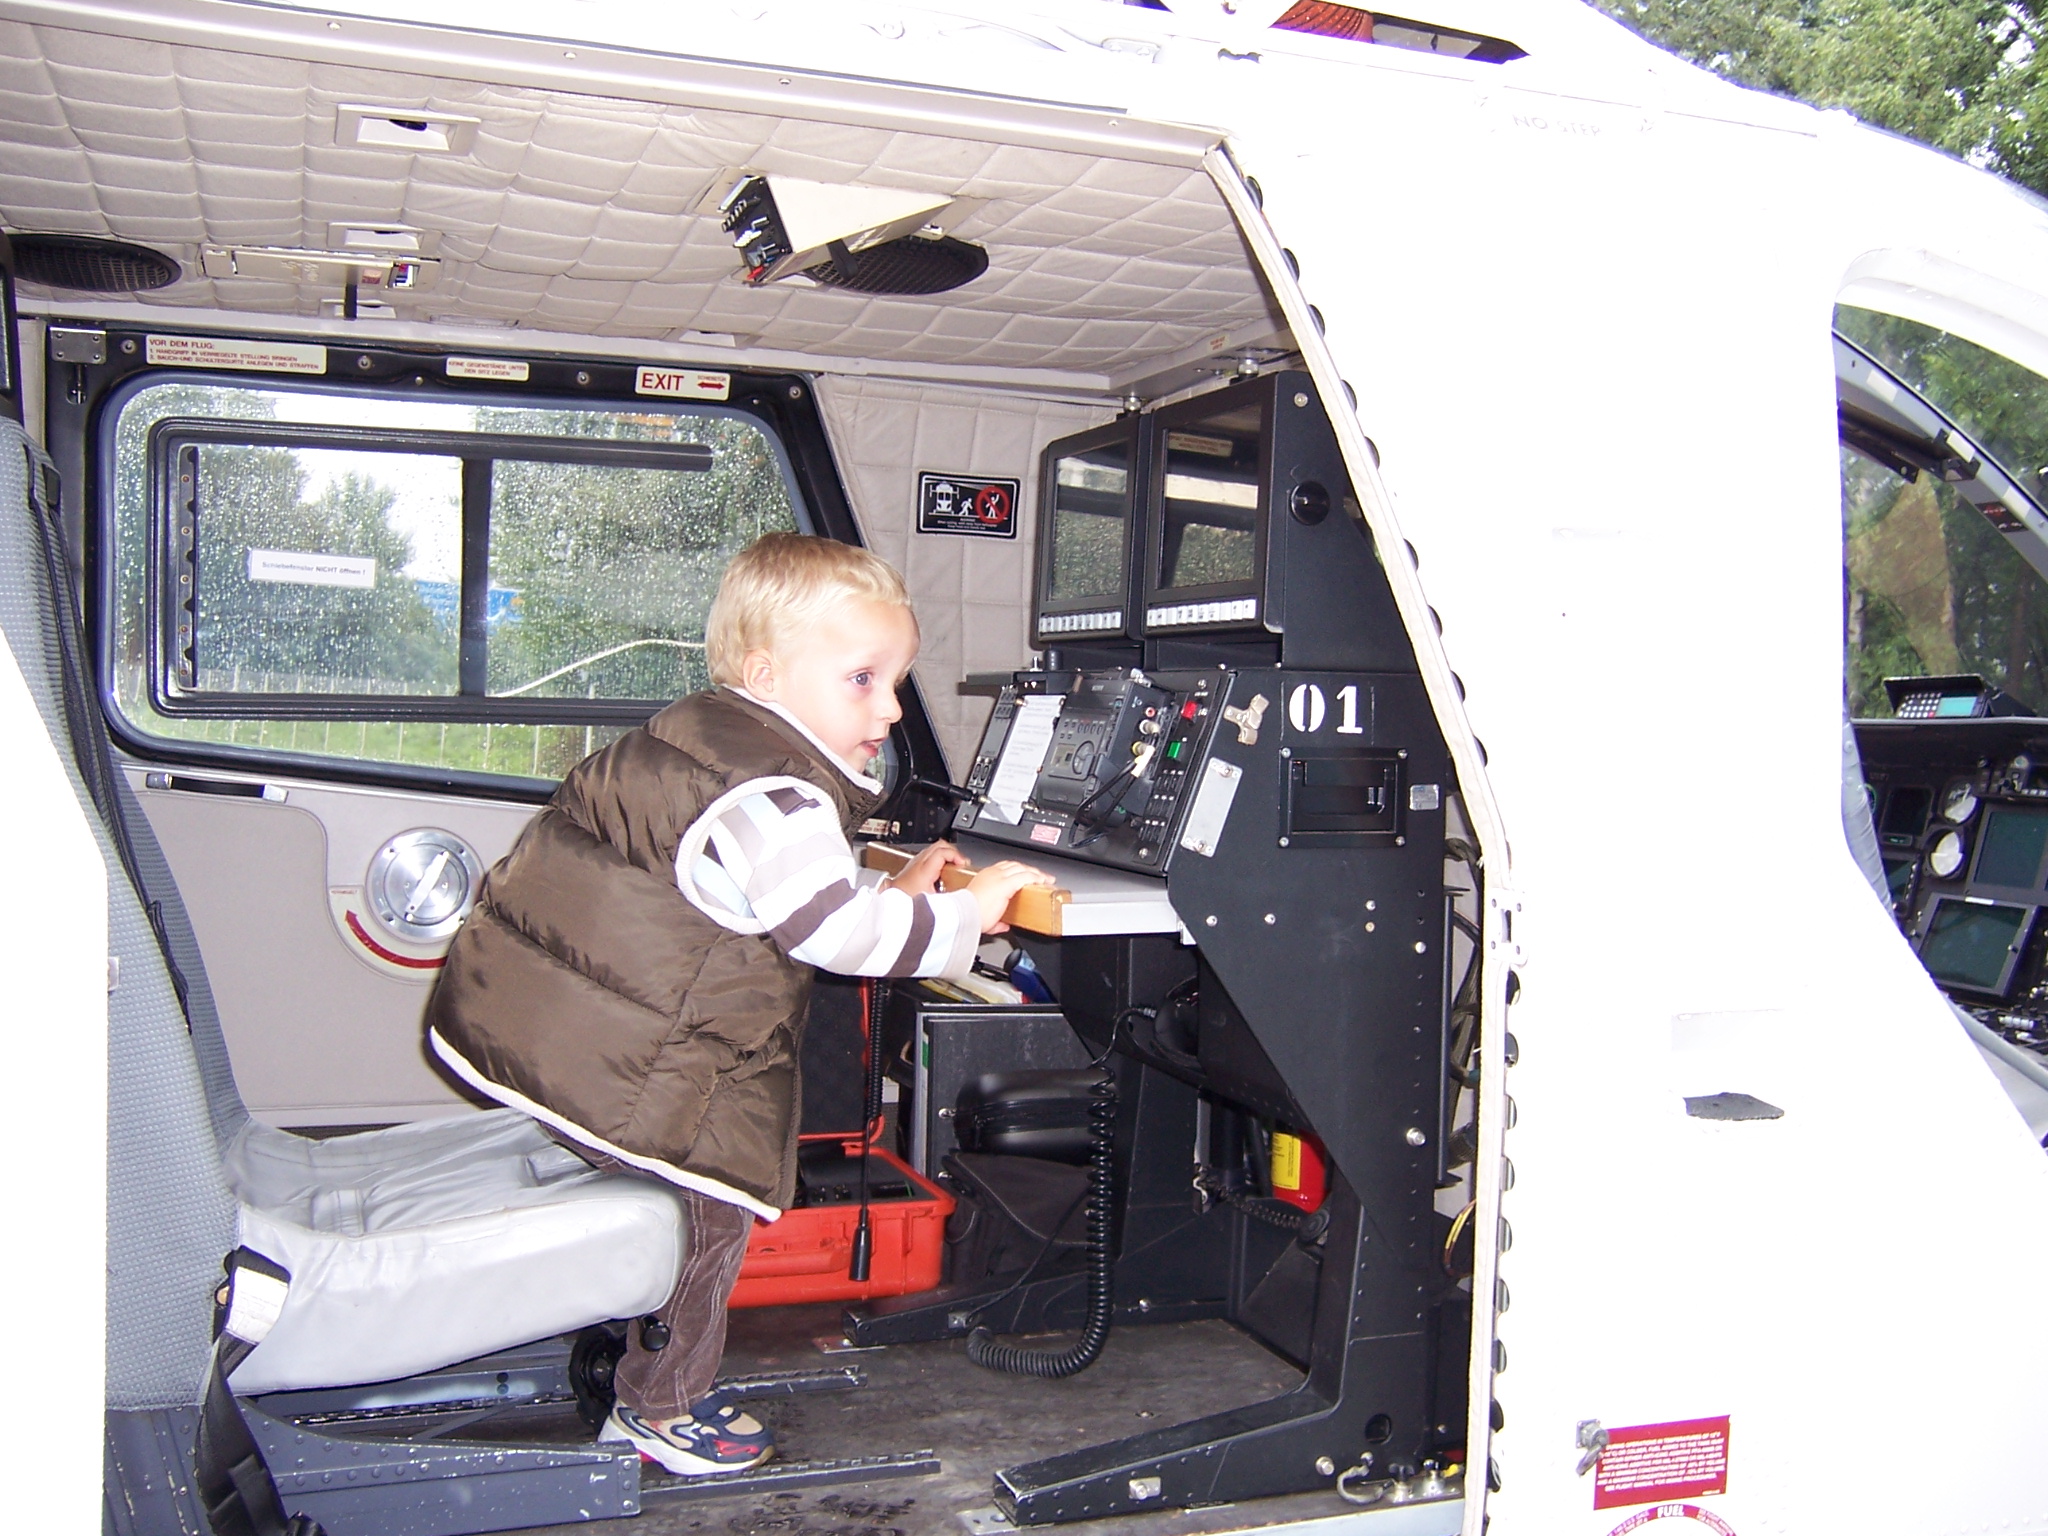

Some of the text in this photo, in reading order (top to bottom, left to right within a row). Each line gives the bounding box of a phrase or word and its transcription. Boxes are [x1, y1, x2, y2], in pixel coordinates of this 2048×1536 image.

[1512, 114, 1601, 136] NO STEP
[149, 339, 215, 349] VOR DEM FLUG:
[641, 372, 684, 391] EXIT
[262, 561, 314, 572] Schiebefenster
[315, 566, 337, 574] NICHT
[339, 567, 361, 575] öffnen
[1289, 683, 1363, 734] 01
[1605, 1442, 1624, 1450] DURING
[1625, 1438, 1656, 1448] OPERATIONS
[1663, 1433, 1701, 1443] TEMPERATURES
[1661, 1442, 1678, 1451] ADDED
[1624, 1454, 1642, 1462] EITHER
[1668, 1448, 1690, 1456] ADDITIVE
[1629, 1459, 1651, 1468] ADDITIVE
[1637, 1463, 1679, 1474] CONCENTRATION
[1636, 1470, 1678, 1481] CONCENTRATION
[1615, 1482, 1632, 1490] FLIGHT
[1657, 1504, 1683, 1517] FUEL
